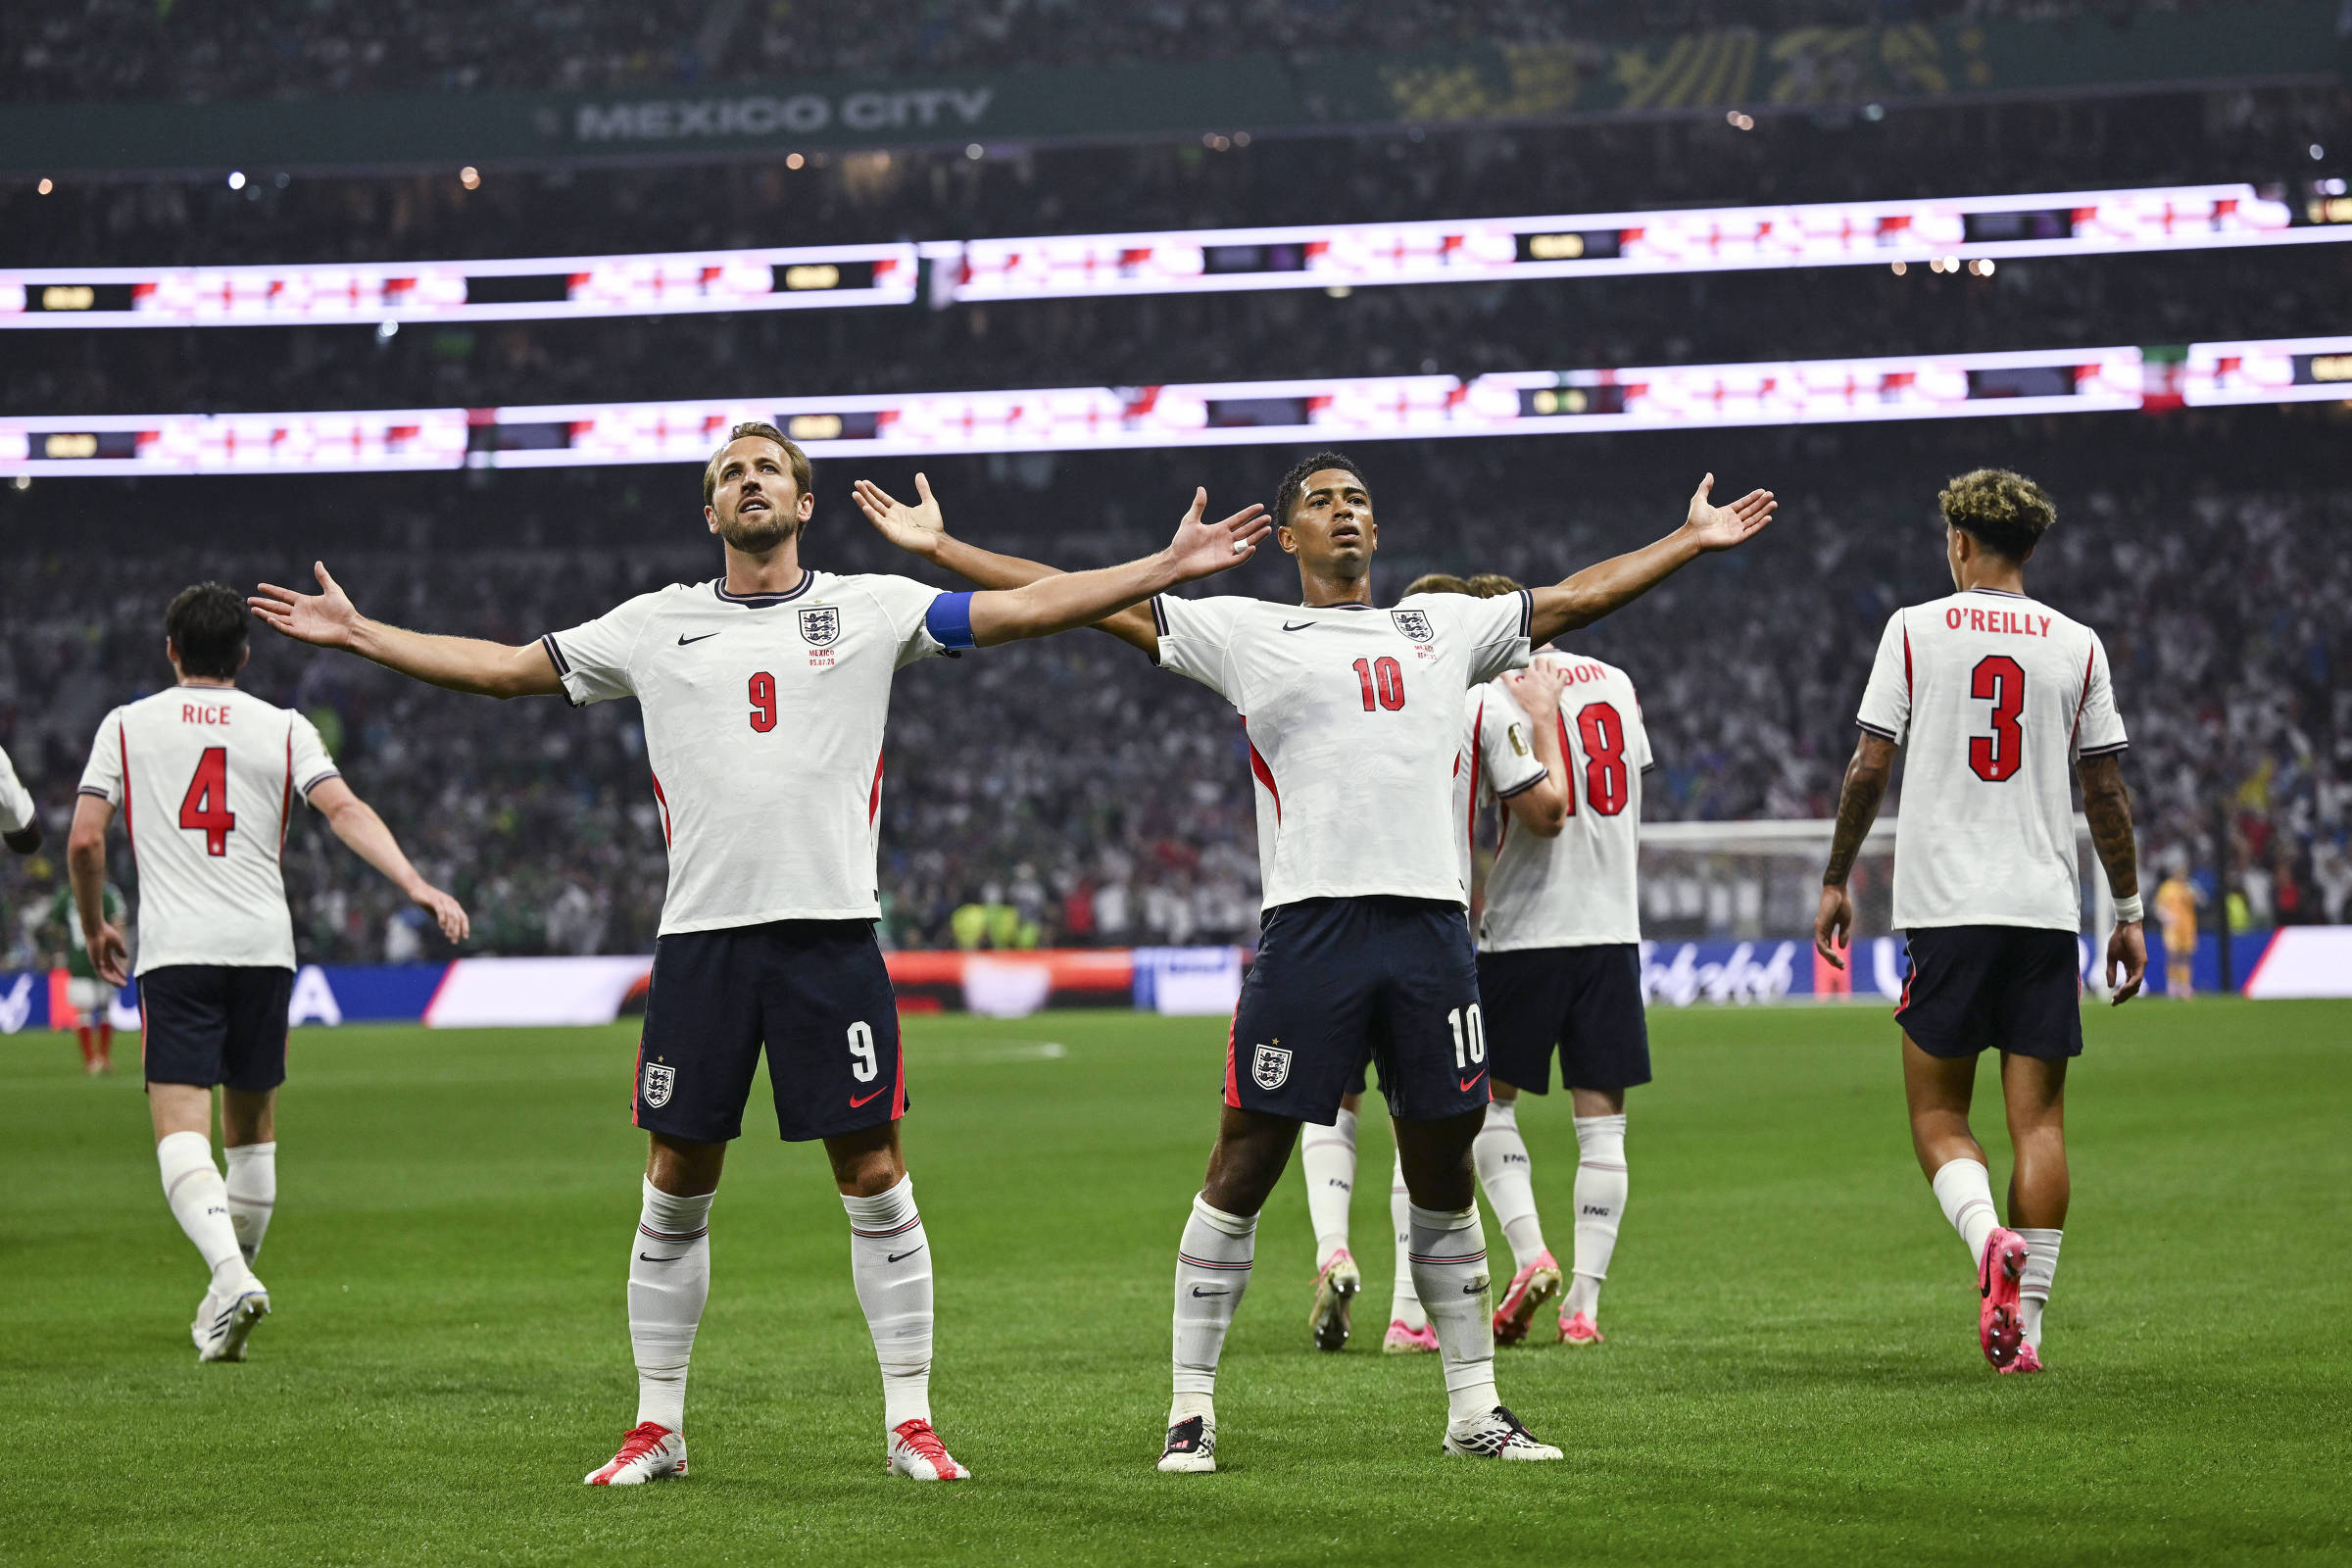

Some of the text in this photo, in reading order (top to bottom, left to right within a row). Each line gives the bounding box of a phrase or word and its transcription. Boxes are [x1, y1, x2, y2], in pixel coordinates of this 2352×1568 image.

[576, 87, 991, 141] MEXICO CITY
[1946, 608, 2052, 637] O'REILLY
[809, 649, 835, 658] MEXICO
[749, 671, 777, 733] 9
[1352, 657, 1405, 711] 10
[182, 705, 231, 725] RICE
[1969, 655, 2026, 782] 3
[179, 746, 235, 857] 4
[847, 1021, 878, 1082] 9
[1448, 1003, 1485, 1068] 10
[1582, 1204, 1610, 1217] ENG
